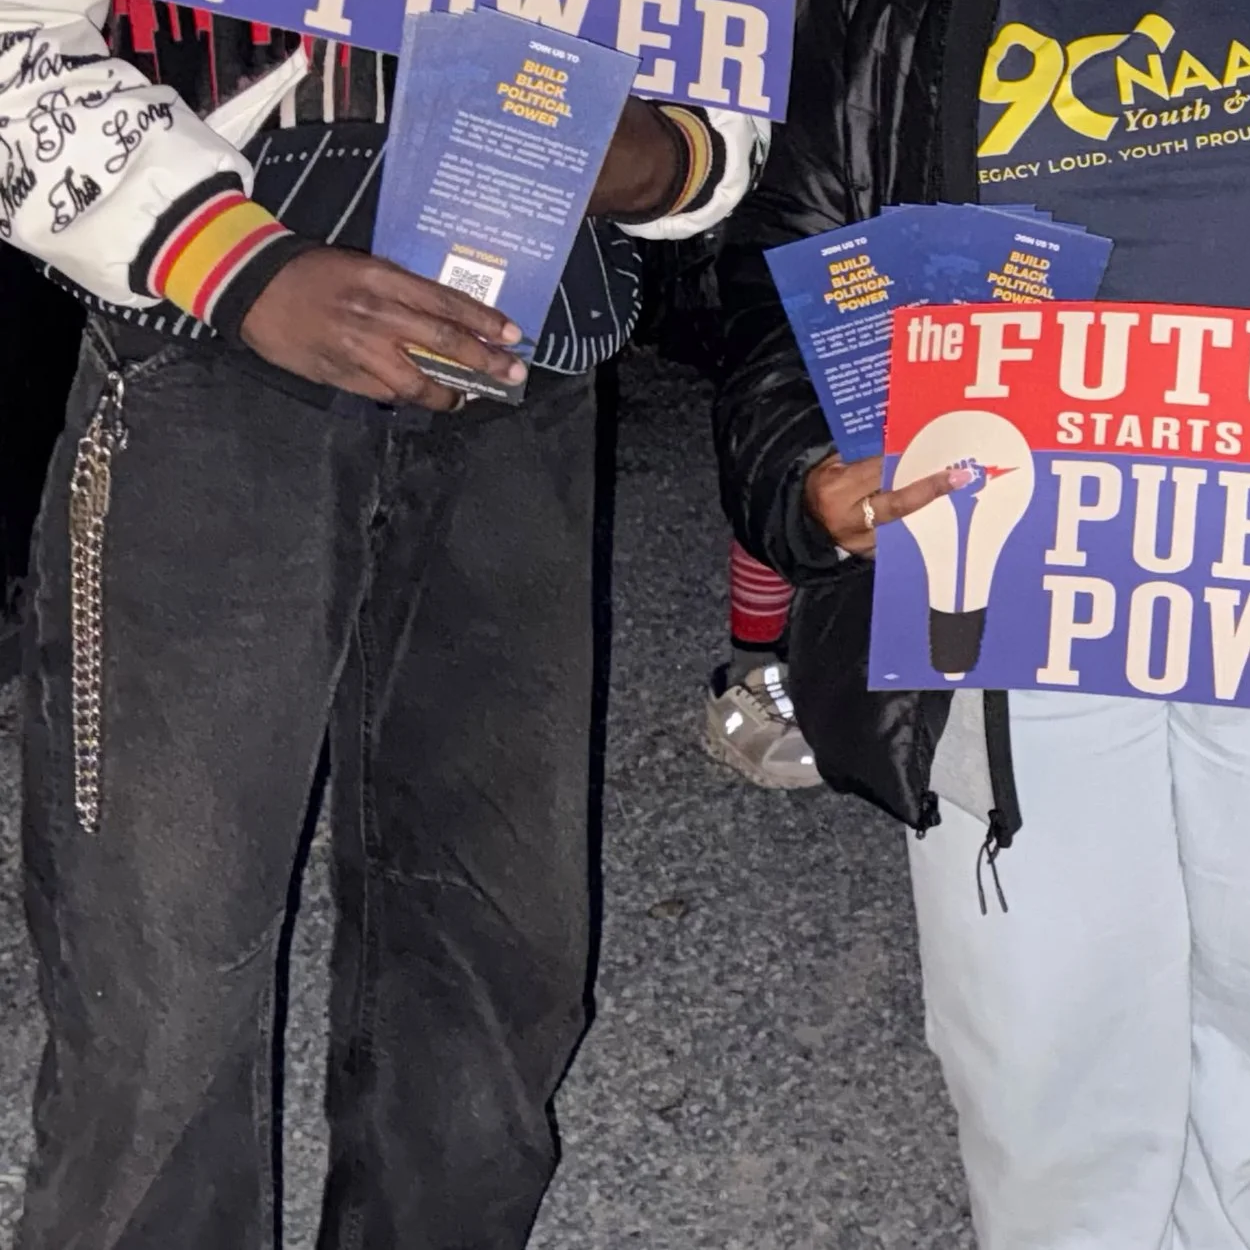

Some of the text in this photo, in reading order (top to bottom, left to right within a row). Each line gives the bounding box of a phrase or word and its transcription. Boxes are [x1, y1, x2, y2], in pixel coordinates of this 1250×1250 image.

[552, 47, 566, 59] US
[566, 52, 580, 64] TO
[522, 59, 569, 84] BUILD
[515, 72, 567, 99] BLACK
[496, 81, 573, 118] POLITICAL
[1124, 98, 1211, 133] Youth
[1223, 90, 1250, 114] &
[502, 99, 559, 128] POWER
[978, 161, 1041, 185] EGACY
[1048, 151, 1113, 174] LOUD.
[1118, 138, 1189, 162] YOUTH
[842, 240, 855, 251] US
[855, 236, 868, 246] TO
[1048, 241, 1060, 252] TO
[829, 254, 871, 276] BUILD
[1003, 262, 1049, 284] BLACK
[1010, 250, 1051, 270] BUILD
[823, 275, 895, 305] POLITICAL
[831, 266, 878, 289] BLACK
[987, 271, 1056, 300] POLITICAL
[837, 290, 889, 314] POWER
[907, 314, 964, 362] the
[1056, 410, 1243, 455] STARTS
